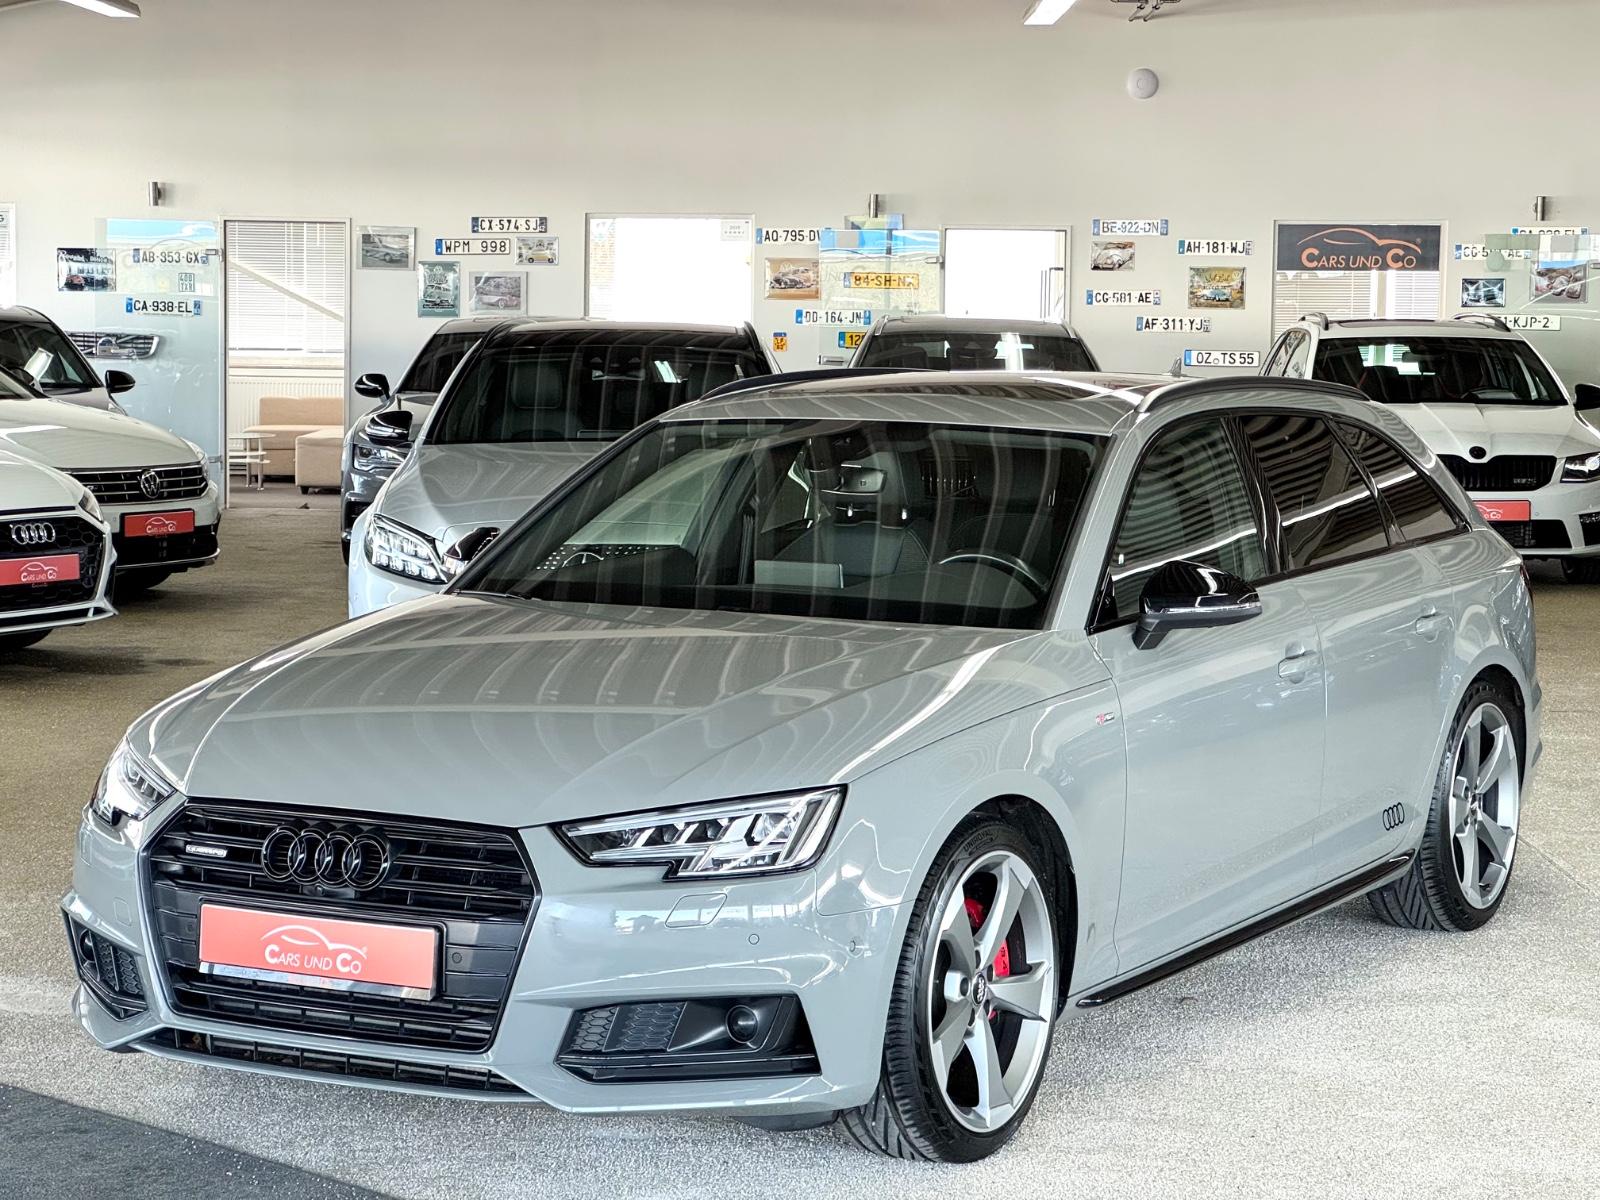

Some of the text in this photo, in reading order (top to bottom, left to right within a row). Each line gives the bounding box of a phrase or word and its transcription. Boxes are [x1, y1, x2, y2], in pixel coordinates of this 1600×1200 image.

[479, 219, 538, 231] CX-574-SJ
[444, 240, 507, 253] WPM 998
[1186, 241, 1245, 254] AH-181-WJ
[1463, 246, 1522, 258] CG-5-AE
[1349, 255, 1382, 268] UND
[133, 300, 193, 313] CA-938-EL
[1143, 318, 1204, 331] AF-311-YJ
[1220, 352, 1236, 365] TS
[1239, 352, 1255, 365] 55
[304, 956, 334, 972] UND
